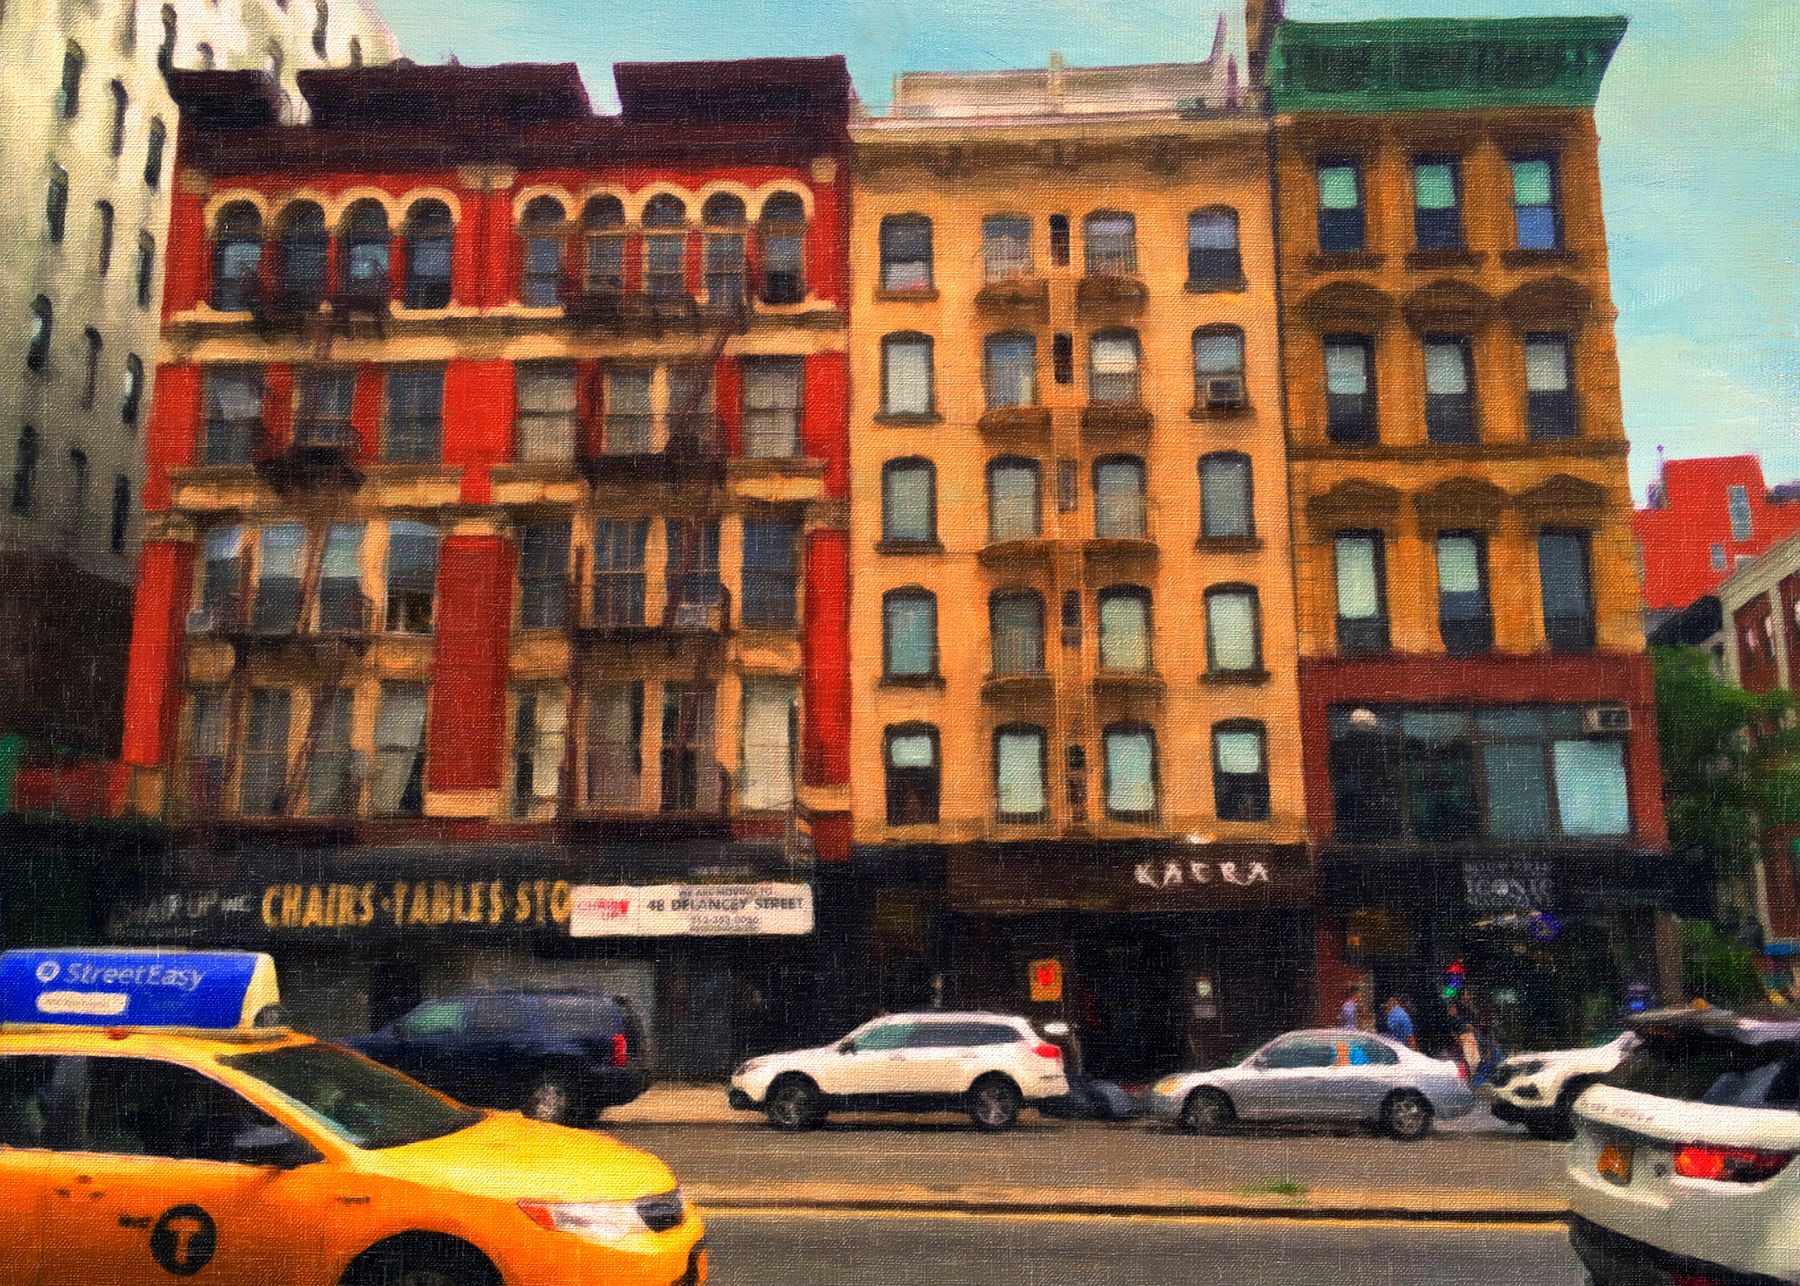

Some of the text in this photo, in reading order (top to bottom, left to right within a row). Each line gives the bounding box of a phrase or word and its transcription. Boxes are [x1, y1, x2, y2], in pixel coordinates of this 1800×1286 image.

[262, 882, 375, 928] CHAIRS
[393, 880, 503, 925] TABLES
[671, 898, 747, 911] DELANCEY
[754, 897, 804, 909] STREET
[716, 887, 757, 897] MOVING
[64, 962, 207, 991] StreetEasy
[166, 1218, 200, 1264] T
